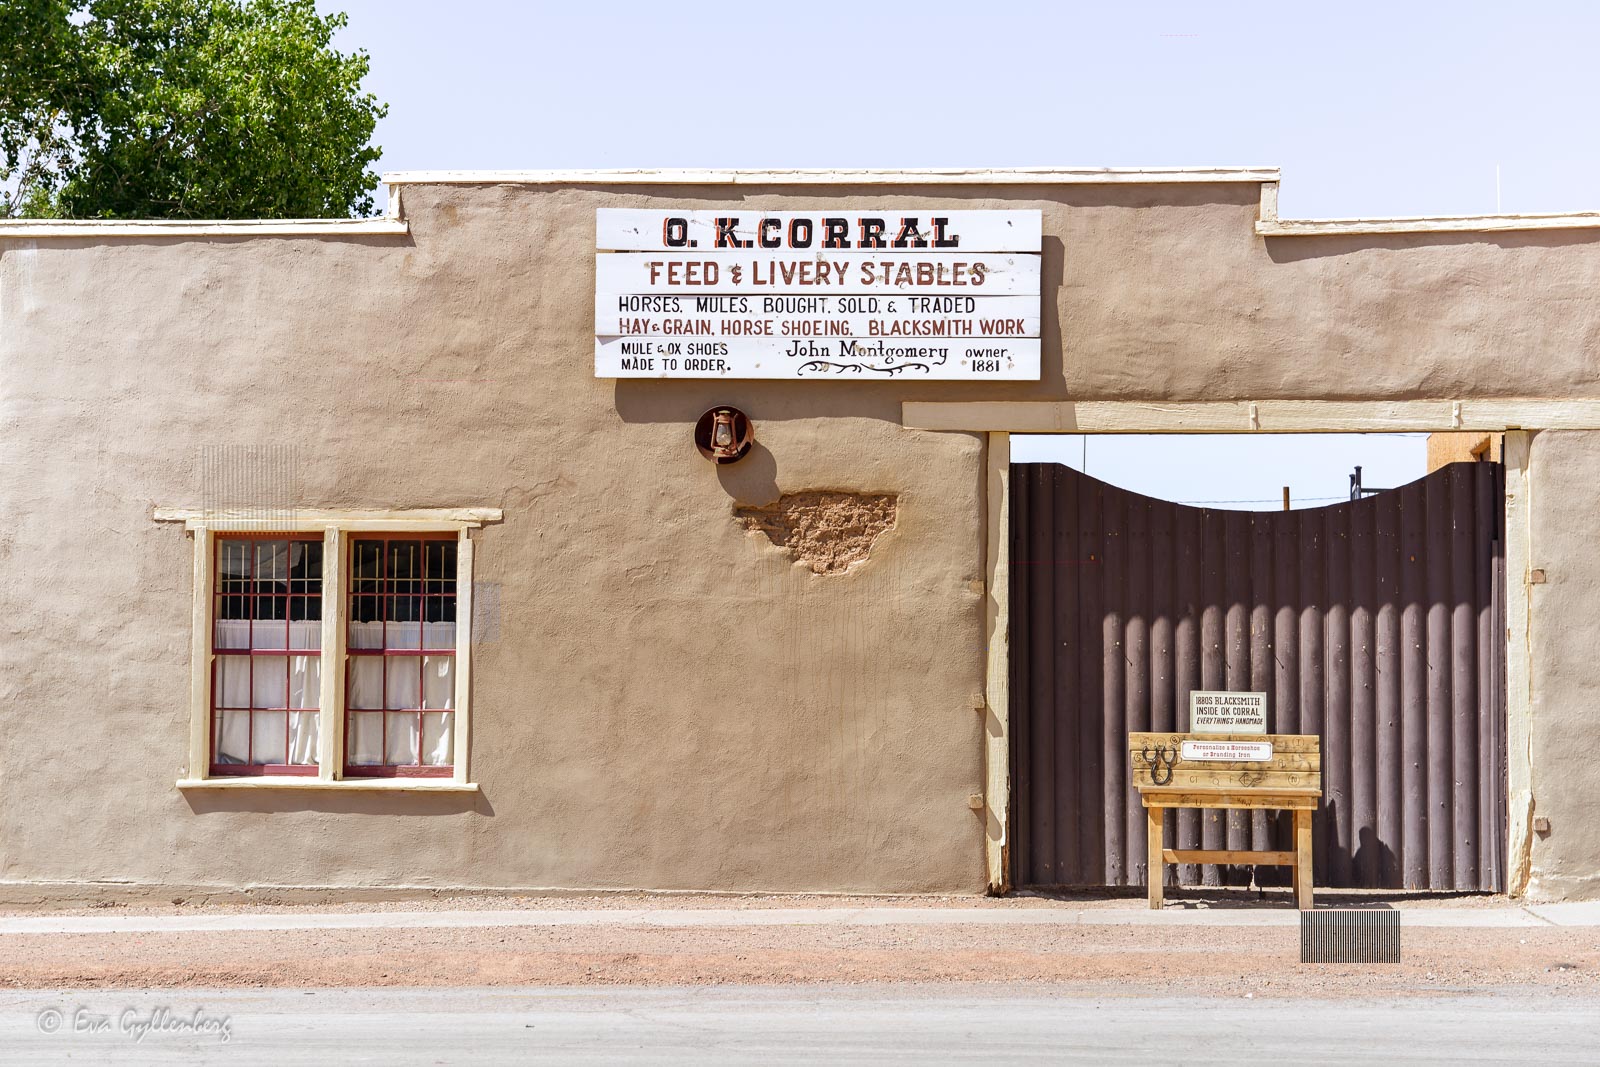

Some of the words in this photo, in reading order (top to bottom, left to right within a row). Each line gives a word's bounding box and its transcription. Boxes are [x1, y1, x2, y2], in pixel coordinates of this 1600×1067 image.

[663, 217, 698, 248] O.
[650, 261, 719, 286] FEED
[731, 263, 743, 286] &
[752, 261, 850, 286] LIVERY
[860, 261, 986, 287] STABLES
[887, 301, 897, 313] &
[908, 297, 976, 314] TRADED
[721, 319, 774, 336] HORSE
[868, 319, 973, 337] BLACKSMITH
[979, 318, 1026, 335] WORK
[621, 342, 654, 355] MULE
[657, 344, 665, 353] &
[667, 342, 682, 355] OX
[686, 342, 729, 356] SHOES
[785, 340, 831, 357] John
[838, 340, 949, 366] Montgomery
[621, 358, 655, 371] MADE
[662, 358, 678, 371] TO
[684, 358, 732, 371] ORDER.
[972, 359, 1000, 372] 1881
[1214, 696, 1261, 706] BLACKSMITH
[1196, 706, 1218, 716] INSIDE
[1220, 706, 1231, 716] OK
[1232, 707, 1260, 717] CORRAL
[1235, 717, 1264, 726] HANDMADE
